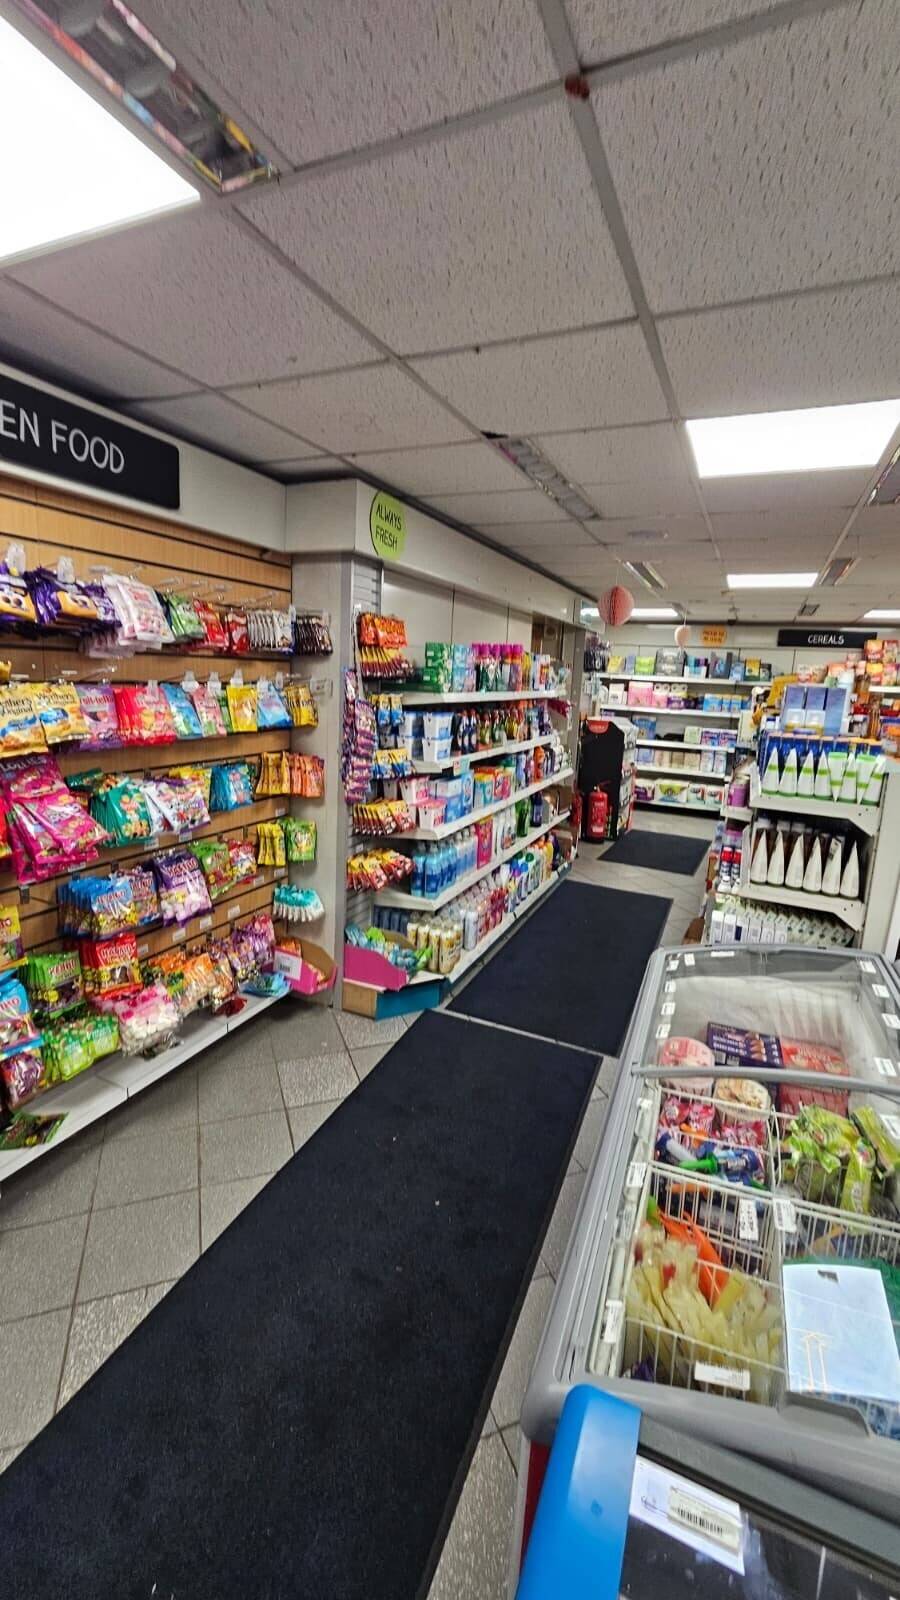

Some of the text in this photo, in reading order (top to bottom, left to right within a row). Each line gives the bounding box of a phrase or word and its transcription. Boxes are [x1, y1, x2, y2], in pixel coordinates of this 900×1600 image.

[51, 419, 125, 474] FOOD
[375, 503, 402, 531] ALWAYS
[375, 524, 398, 552] FRESH
[807, 634, 845, 645] CEREALS
